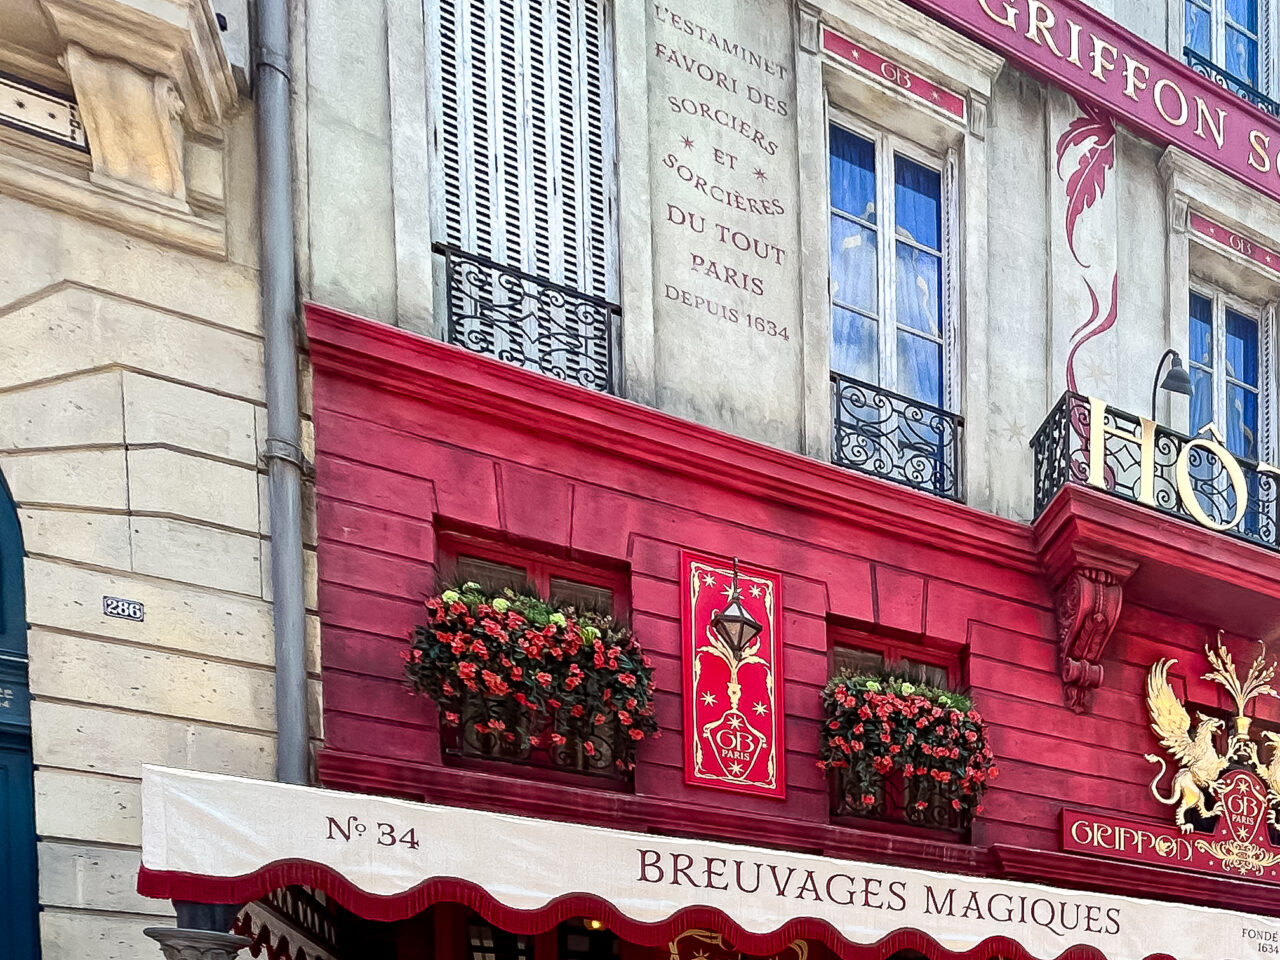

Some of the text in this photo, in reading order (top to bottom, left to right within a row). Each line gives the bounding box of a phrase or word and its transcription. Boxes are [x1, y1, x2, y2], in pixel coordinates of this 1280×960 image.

[653, 3, 788, 81] L'ESTAMINET
[655, 42, 788, 117] FAVORI DES
[977, 0, 1228, 150] GRIFFON
[668, 96, 778, 156] SORCIERS
[713, 147, 738, 170] ET
[662, 153, 785, 216] SORCIÈRES
[666, 203, 786, 266] DU TOUT
[690, 252, 764, 297] PARIS
[664, 283, 790, 341] DEPUIS 1634
[106, 599, 141, 618] 286
[716, 729, 755, 753] GB
[721, 748, 750, 761] PARIS
[1228, 795, 1258, 817] GB
[1232, 814, 1255, 826] PARIS
[376, 822, 420, 850] 34
[636, 847, 1121, 938] BREUVAGES MAGIQUES
[1241, 927, 1279, 943] FONDÉ
[1257, 942, 1279, 955] 1634
